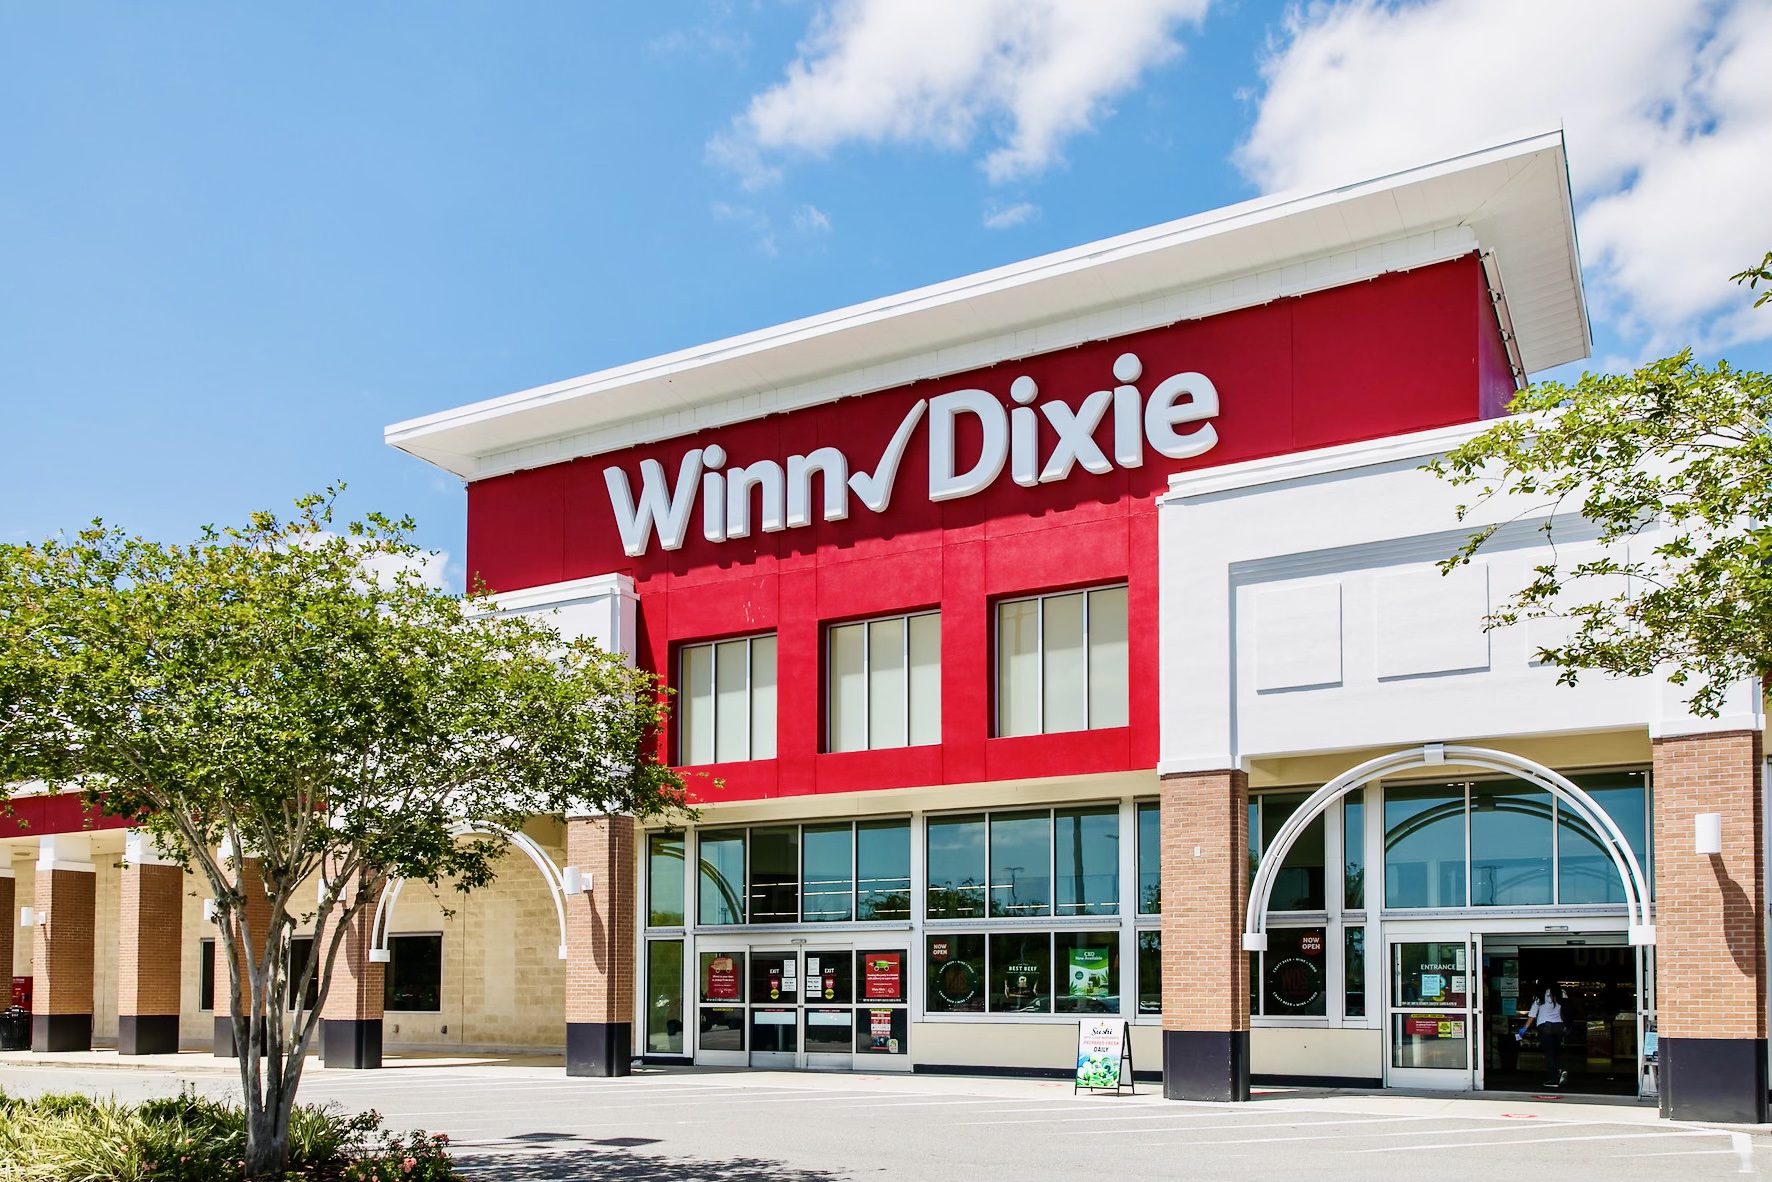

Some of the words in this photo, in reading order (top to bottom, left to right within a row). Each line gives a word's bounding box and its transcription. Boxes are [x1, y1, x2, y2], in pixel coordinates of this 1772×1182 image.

[603, 444, 848, 557] Winn
[928, 352, 1220, 503] Dixie
[1420, 963, 1456, 971] ENTRANCE
[1091, 1027, 1113, 1036] Sushi
